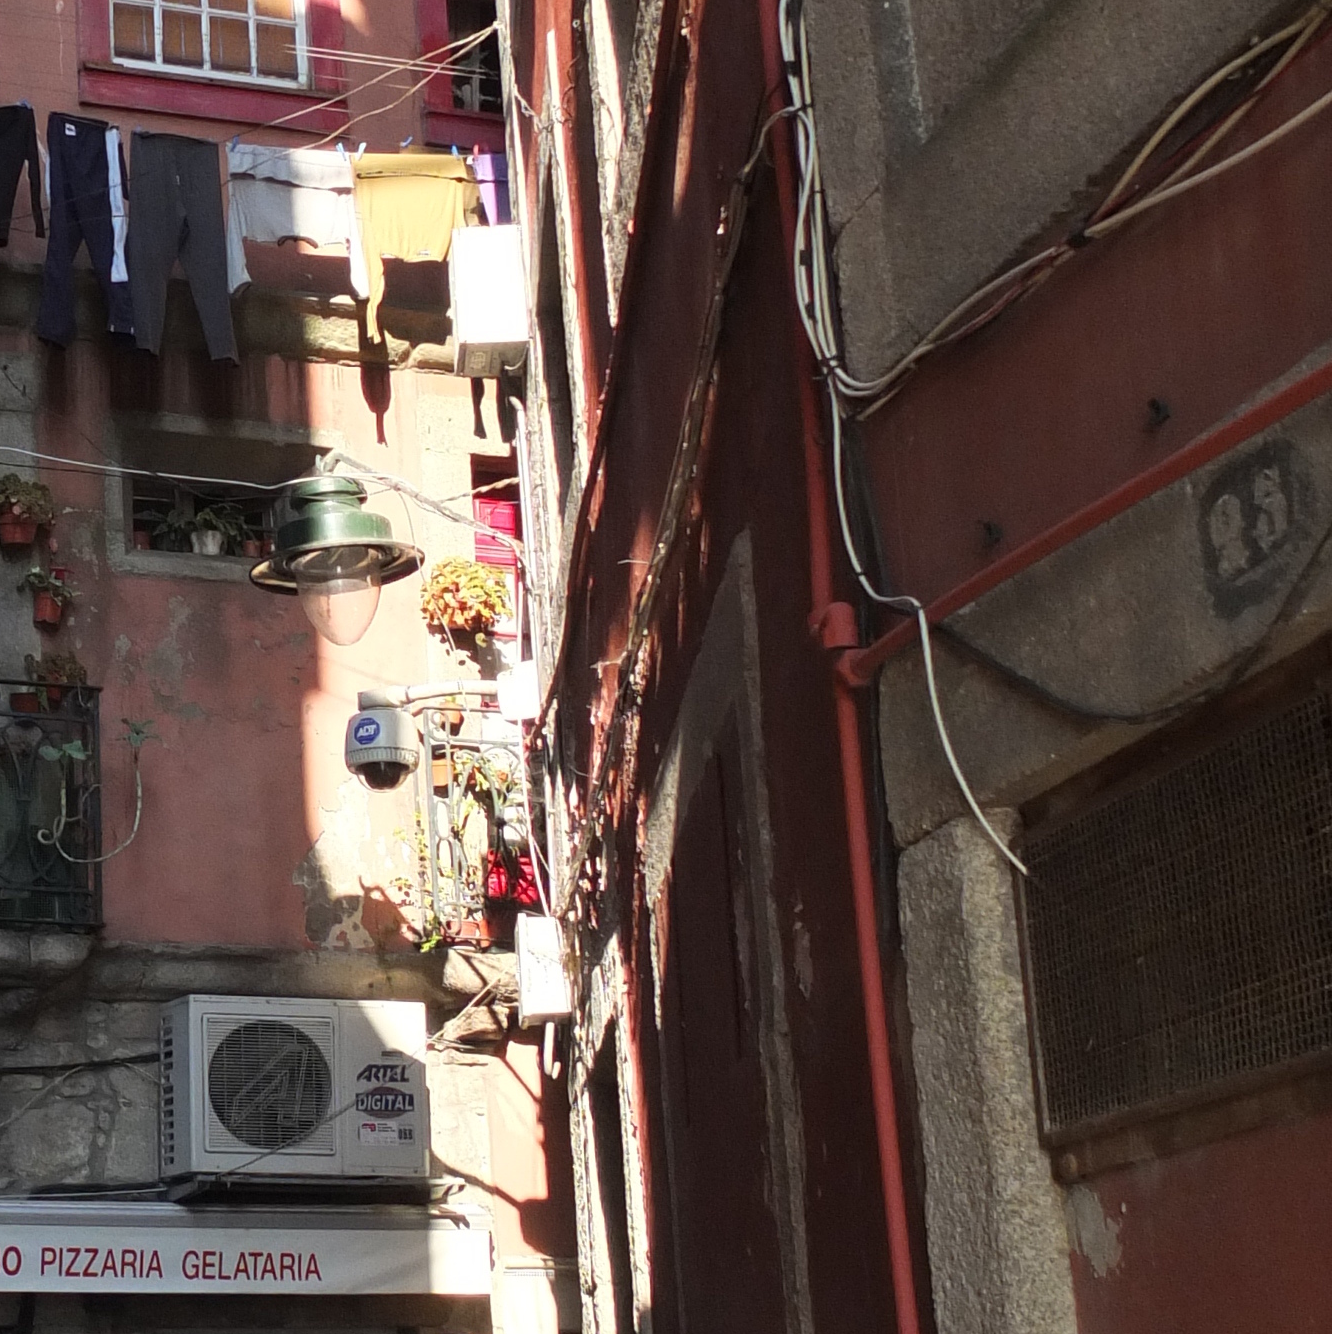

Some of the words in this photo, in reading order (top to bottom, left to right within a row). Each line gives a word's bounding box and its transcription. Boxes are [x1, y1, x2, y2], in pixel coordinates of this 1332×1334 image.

[357, 724, 377, 737] ADT
[357, 1094, 414, 1111] DIGITAL
[40, 1246, 164, 1279] PIZZARIA
[181, 1249, 323, 1282] GELATARIA
